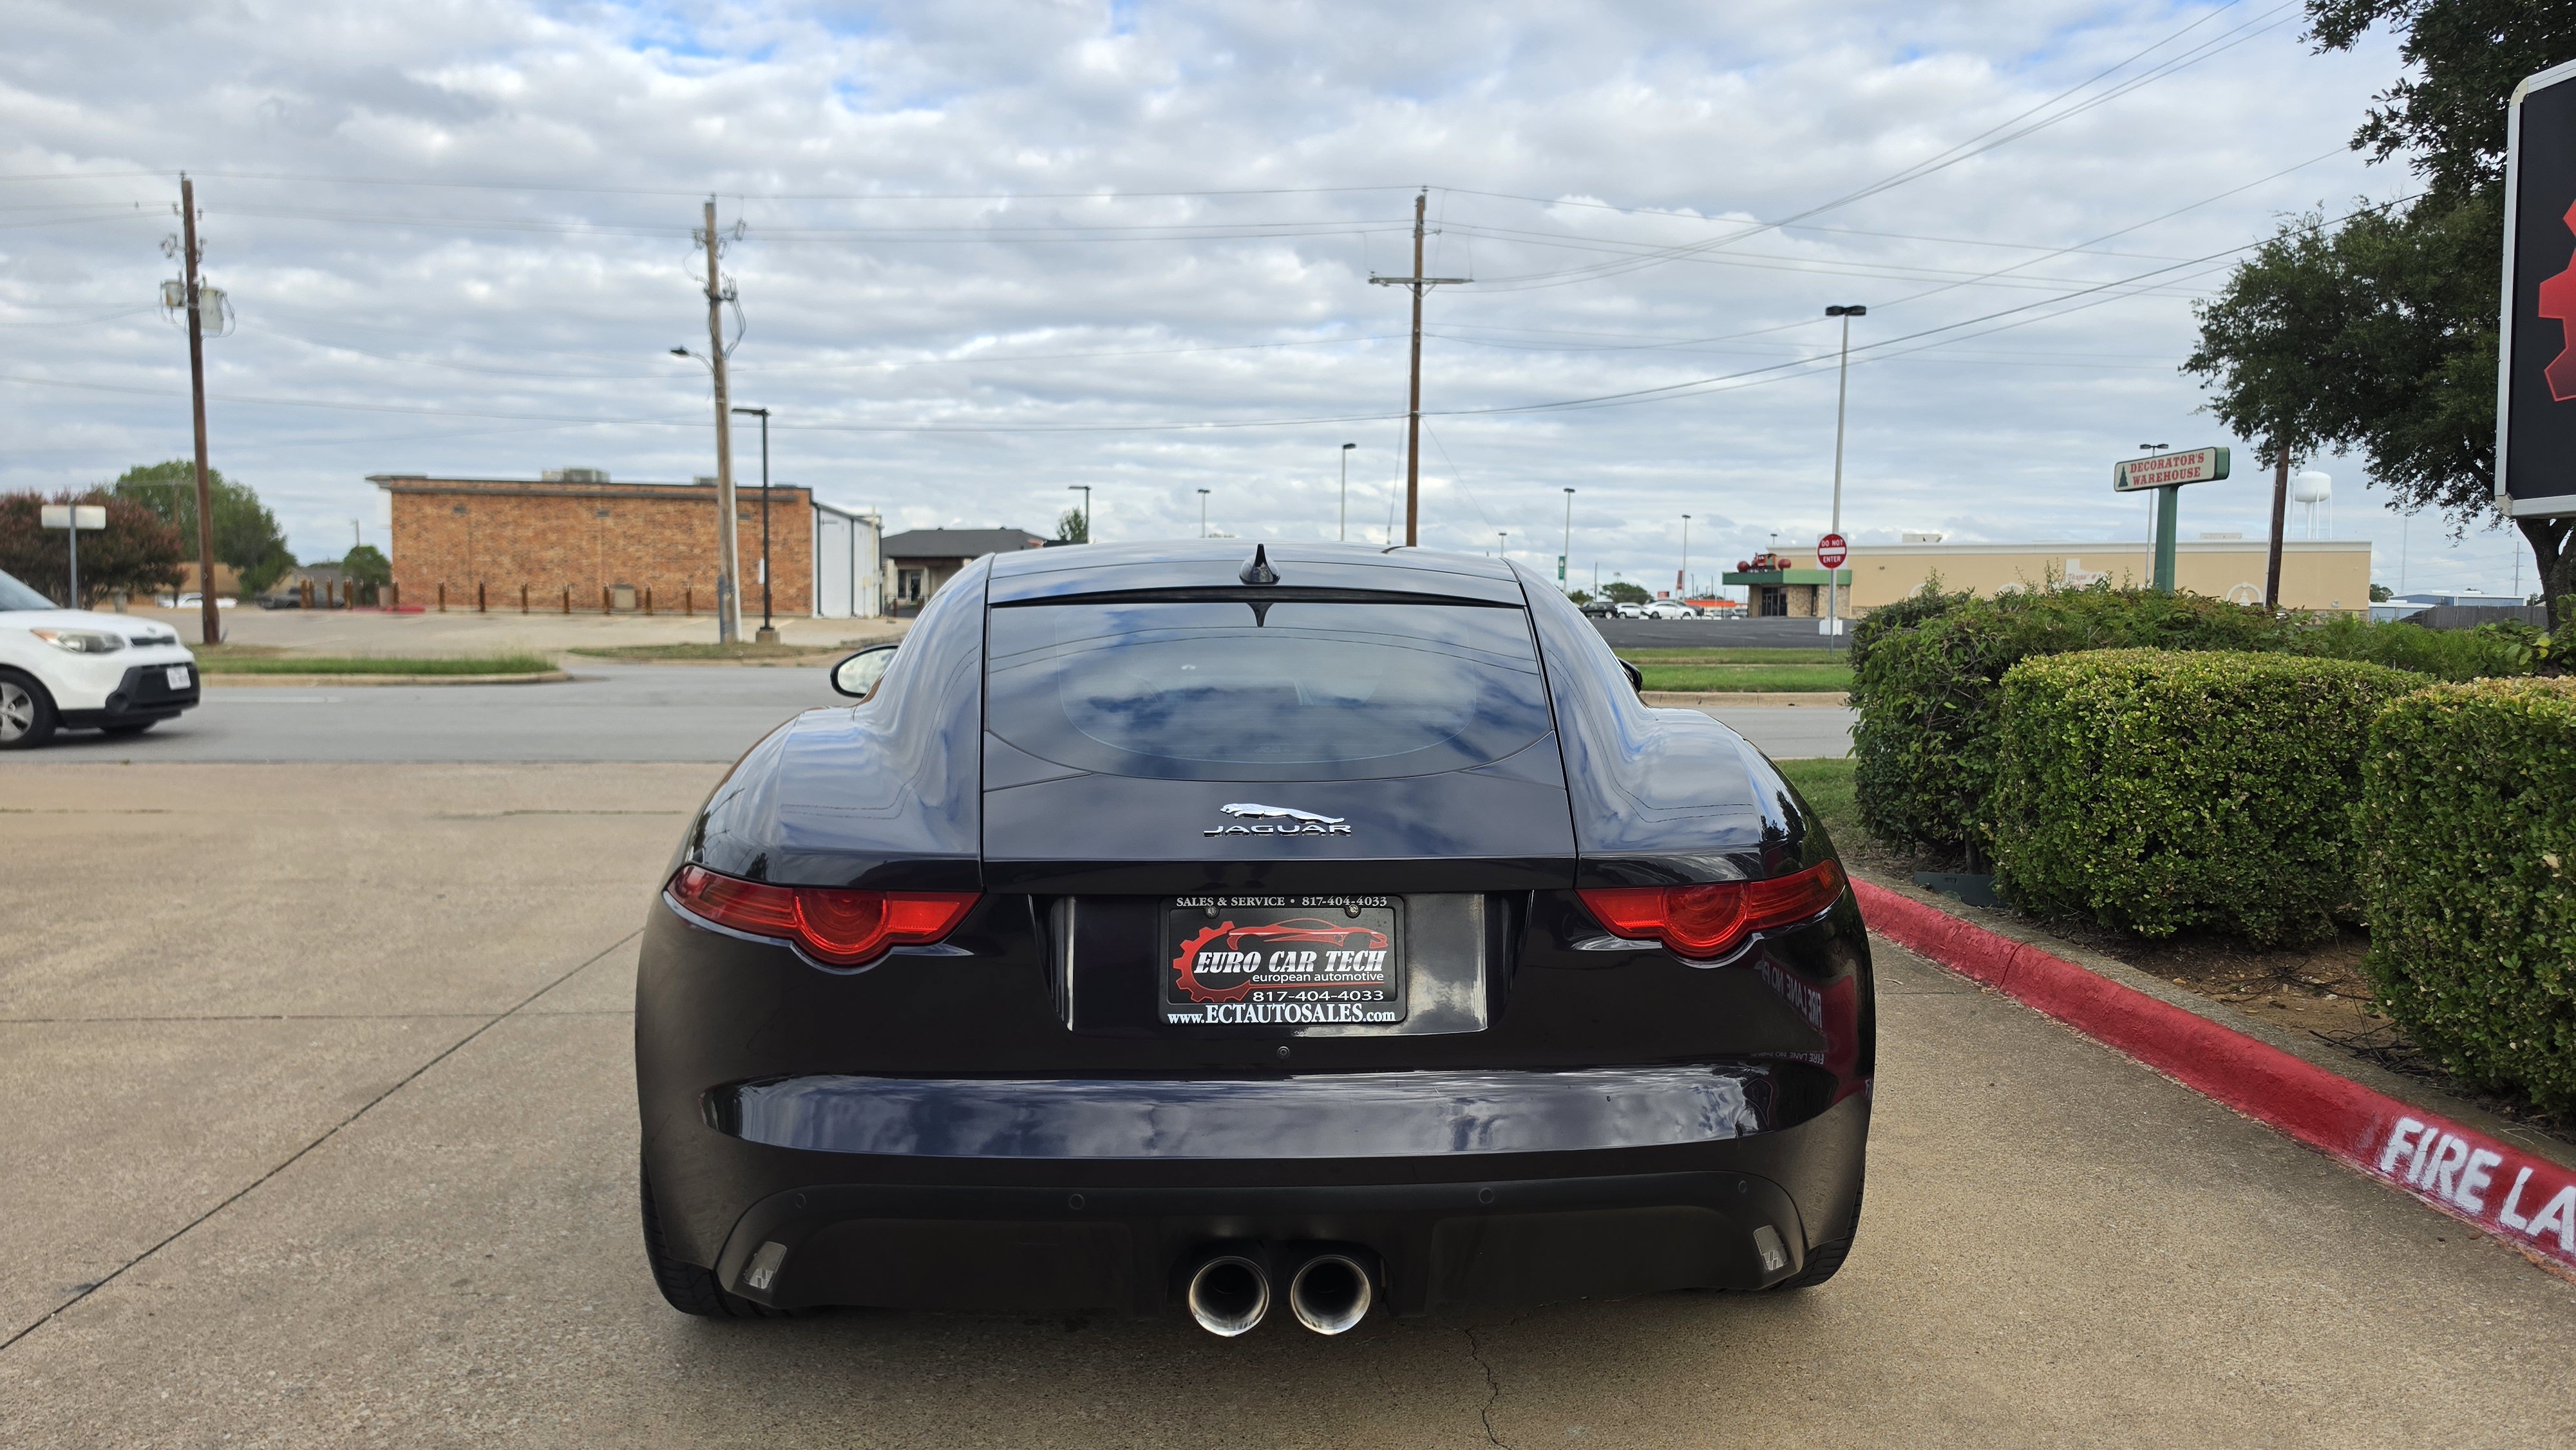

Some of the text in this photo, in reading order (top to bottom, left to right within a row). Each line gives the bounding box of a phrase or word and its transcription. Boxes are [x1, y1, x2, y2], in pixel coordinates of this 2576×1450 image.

[2130, 453, 2204, 473] DECORATOR'S
[2132, 467, 2201, 485] WAREHOUSE
[1204, 825, 1352, 835] JAGUAR
[1176, 896, 1387, 907] SALES & SERVICE 817-404-4033
[1193, 950, 1387, 974] EURO CAR TECH
[1253, 972, 1385, 984] european automotive
[1253, 990, 1384, 1002] 817-404-4033
[1168, 1003, 1396, 1024] www.ECTAUTOSALES.com
[2380, 1116, 2503, 1214] FIRE
